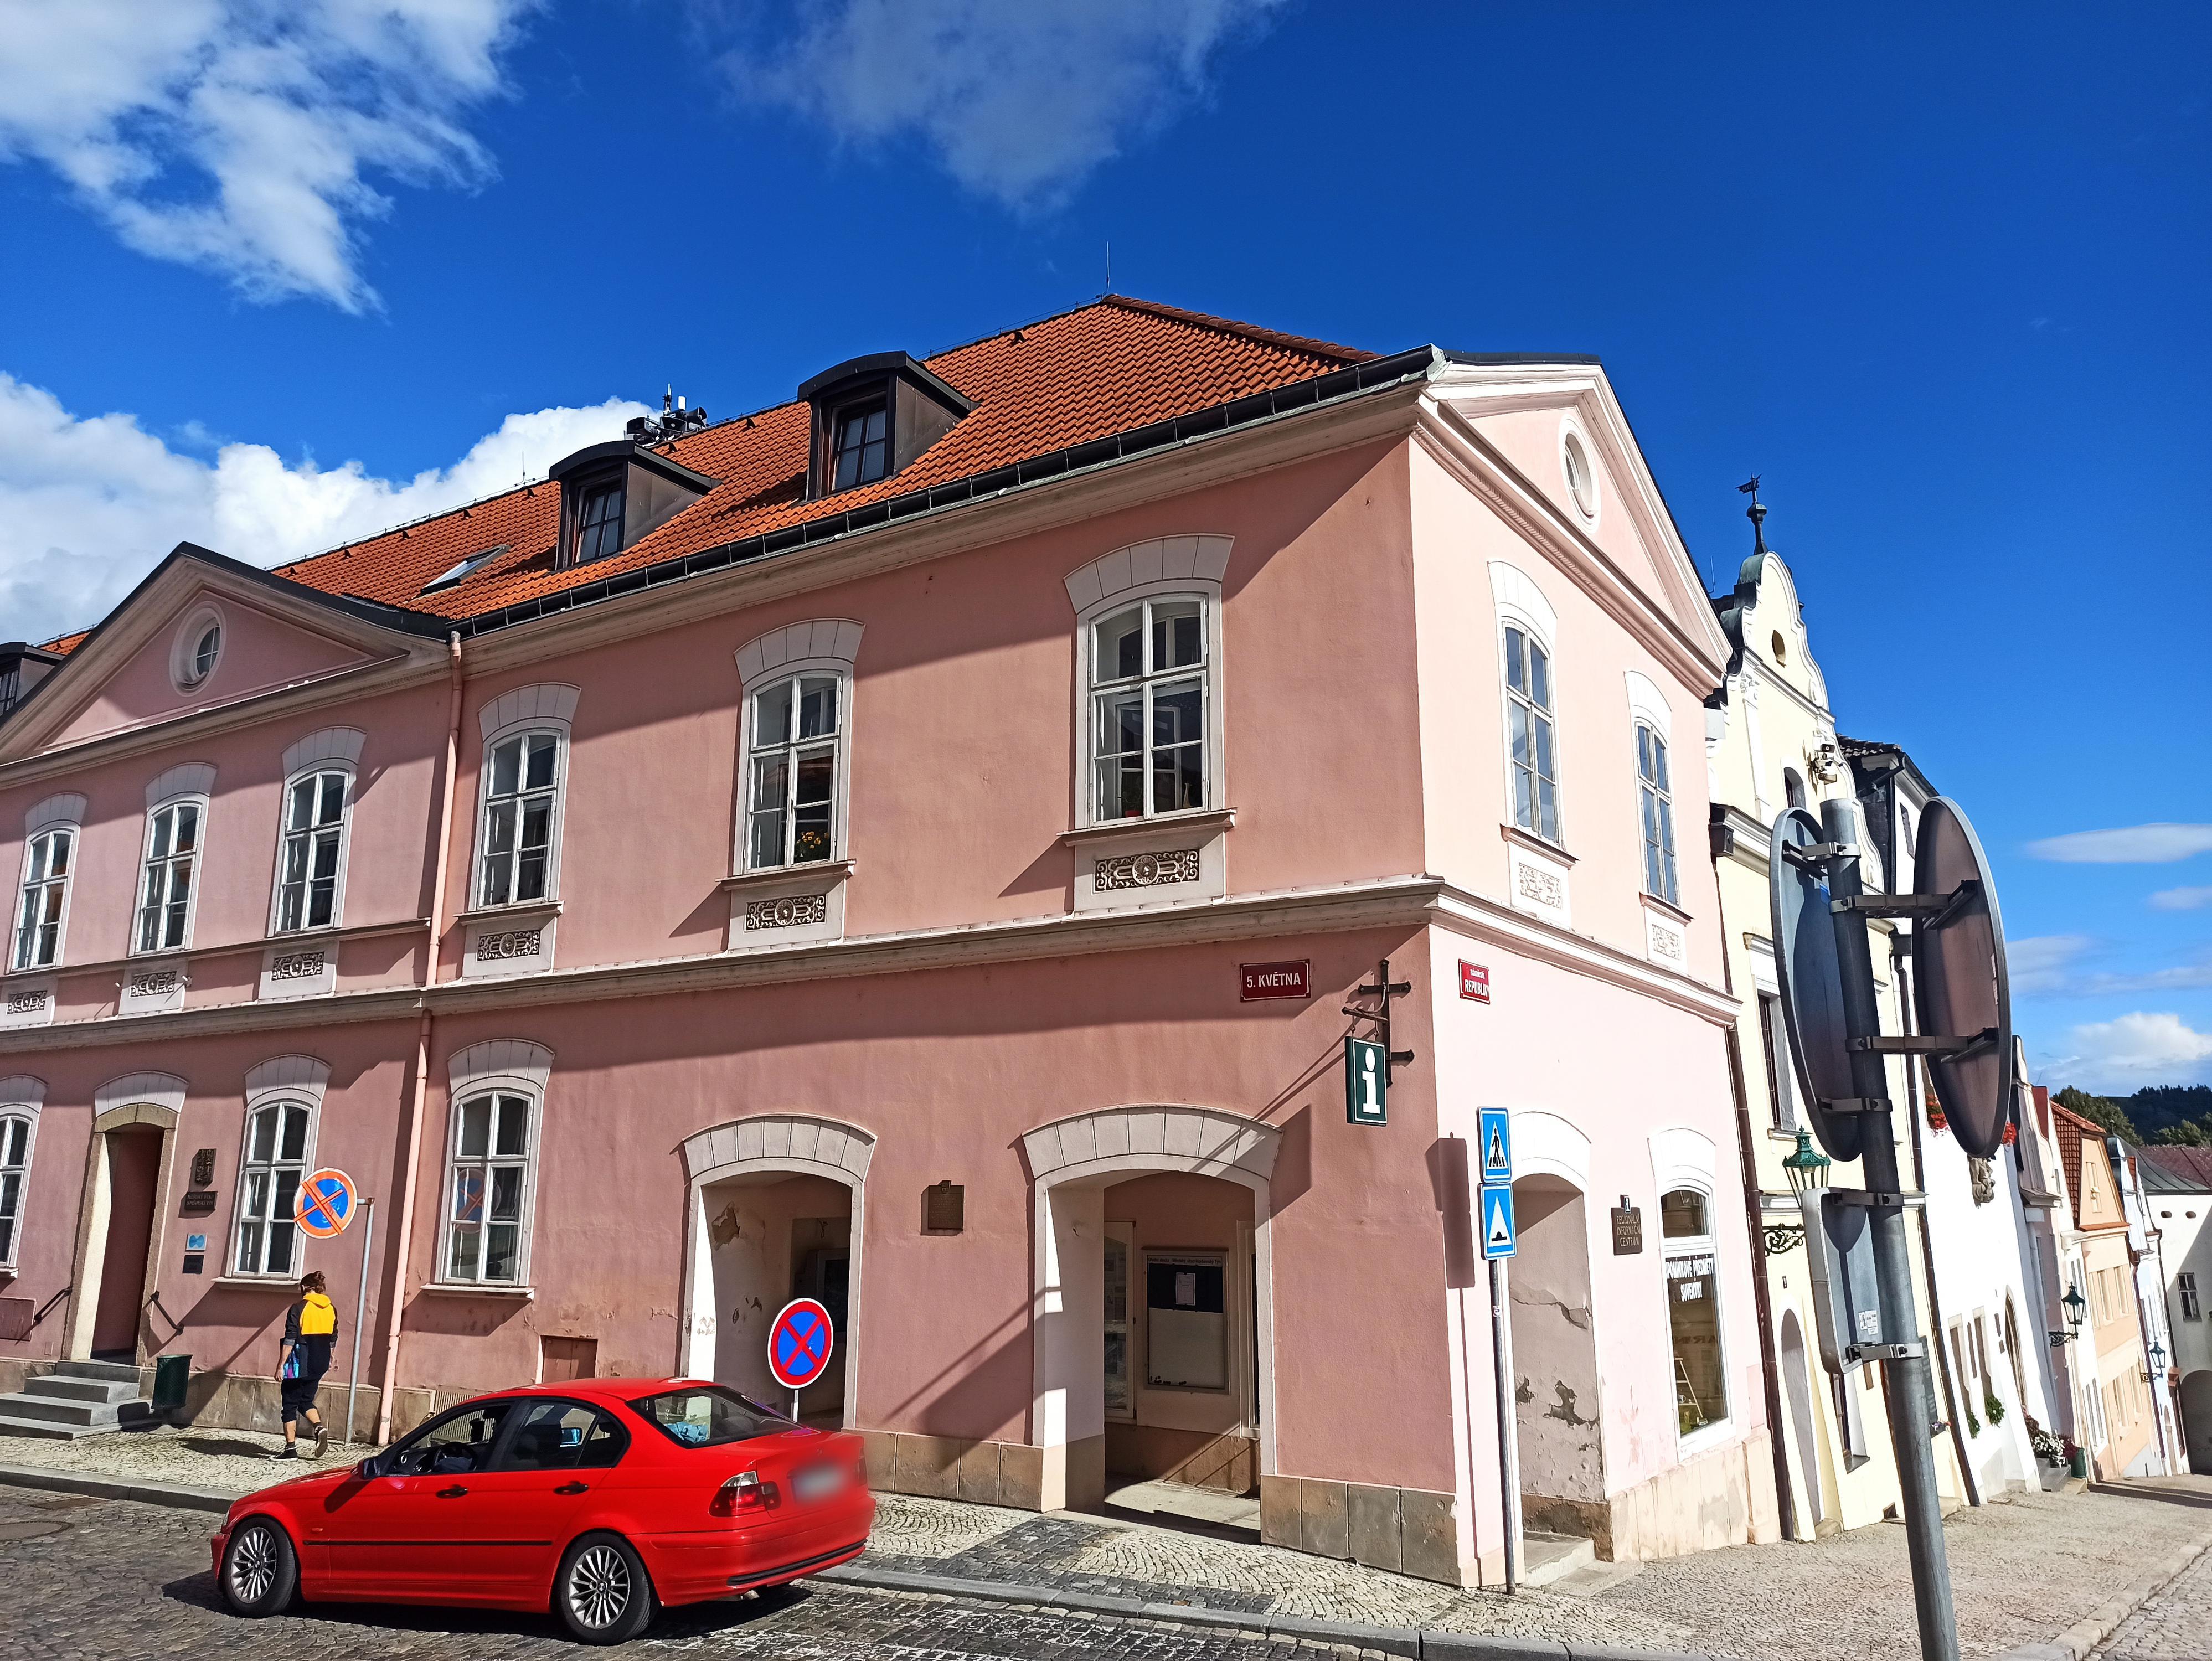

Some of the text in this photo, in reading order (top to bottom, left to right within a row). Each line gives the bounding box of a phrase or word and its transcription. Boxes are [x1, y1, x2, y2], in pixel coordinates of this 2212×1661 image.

[1246, 971, 1301, 988] 5. KVĚTNA
[1465, 979, 1490, 998] REPUBLIKY
[1620, 1236, 1639, 1247] CENTRUM
